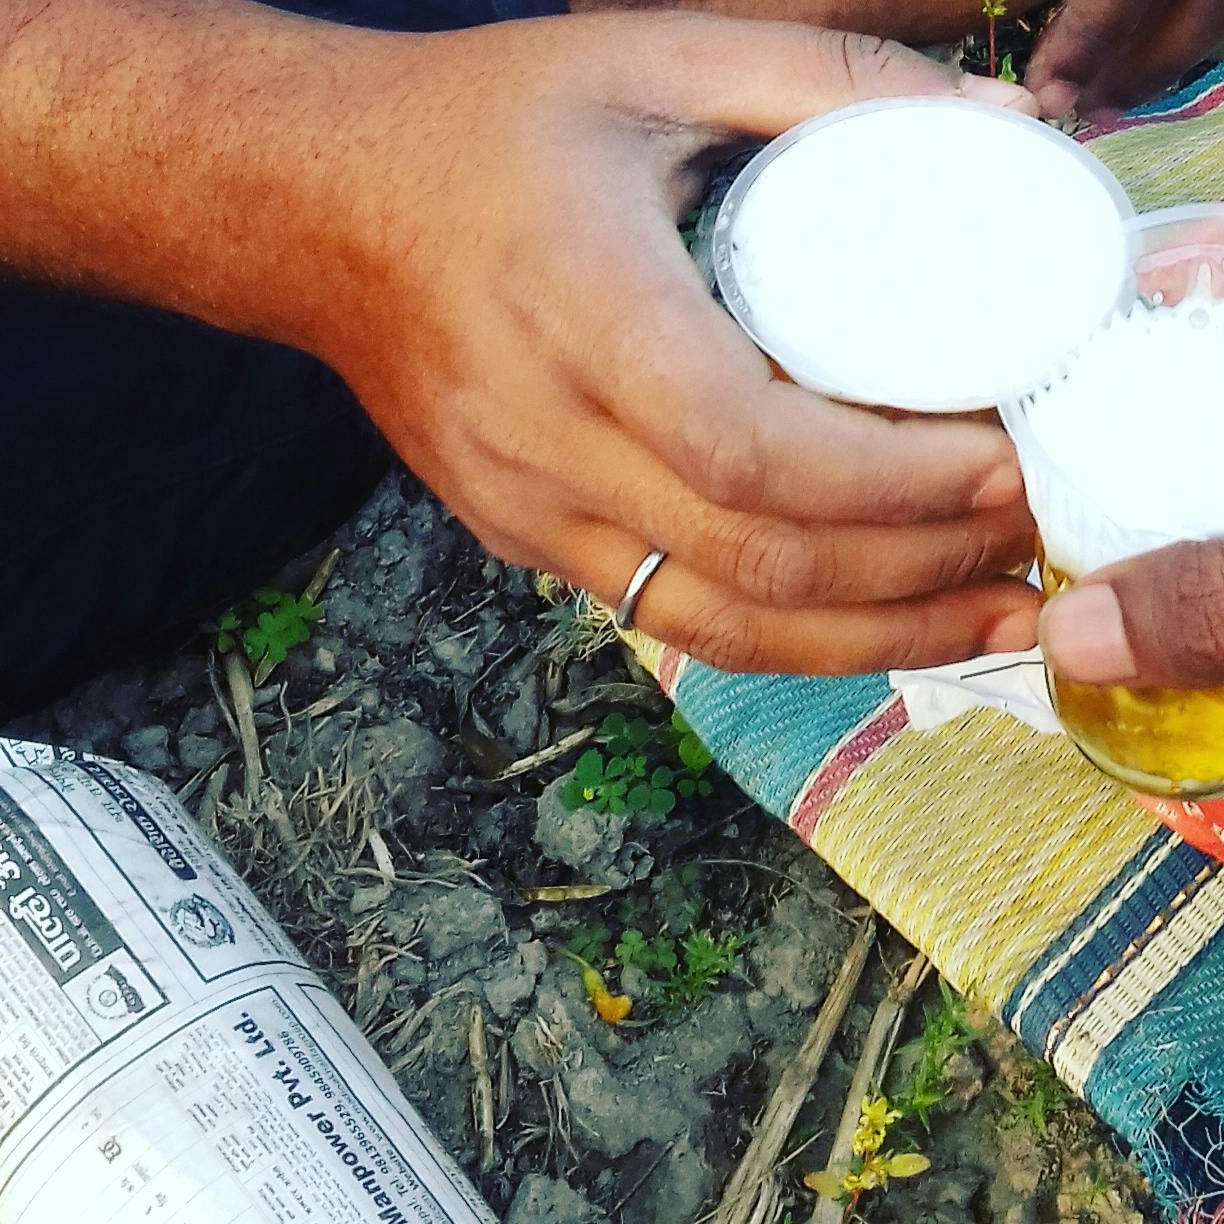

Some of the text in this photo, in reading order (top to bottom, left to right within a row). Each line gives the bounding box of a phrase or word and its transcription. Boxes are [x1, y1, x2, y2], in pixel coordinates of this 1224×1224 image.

[233, 1012, 407, 1224] Manpower Pvt. Ltd.
